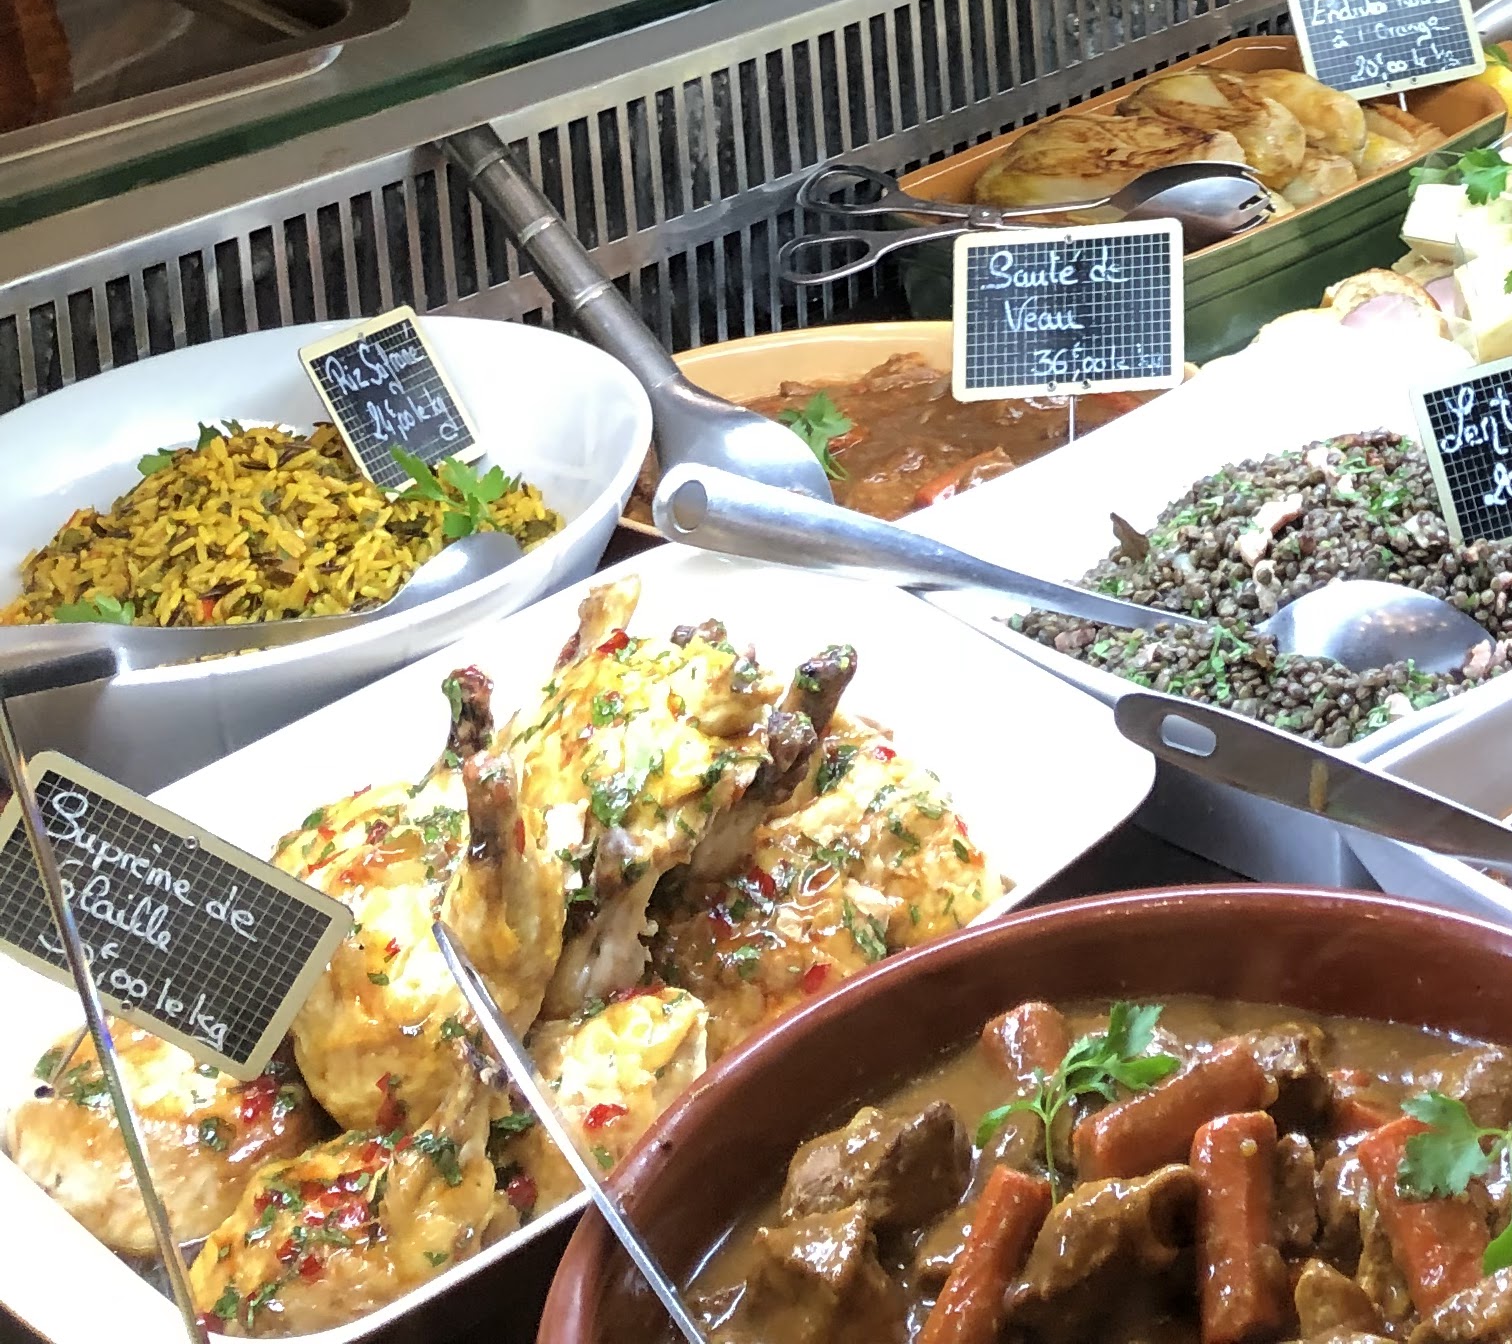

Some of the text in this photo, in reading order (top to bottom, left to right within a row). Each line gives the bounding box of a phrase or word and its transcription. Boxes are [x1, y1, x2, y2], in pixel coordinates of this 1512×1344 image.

[981, 246, 1130, 290] Sauté de
[1004, 296, 1085, 332] Veau
[325, 355, 370, 395] Riz
[1110, 345, 1130, 370] le
[423, 387, 459, 441] kg
[57, 858, 172, 954] olaille
[205, 885, 257, 943] de
[156, 978, 184, 1018] le
[188, 993, 229, 1052] kg
